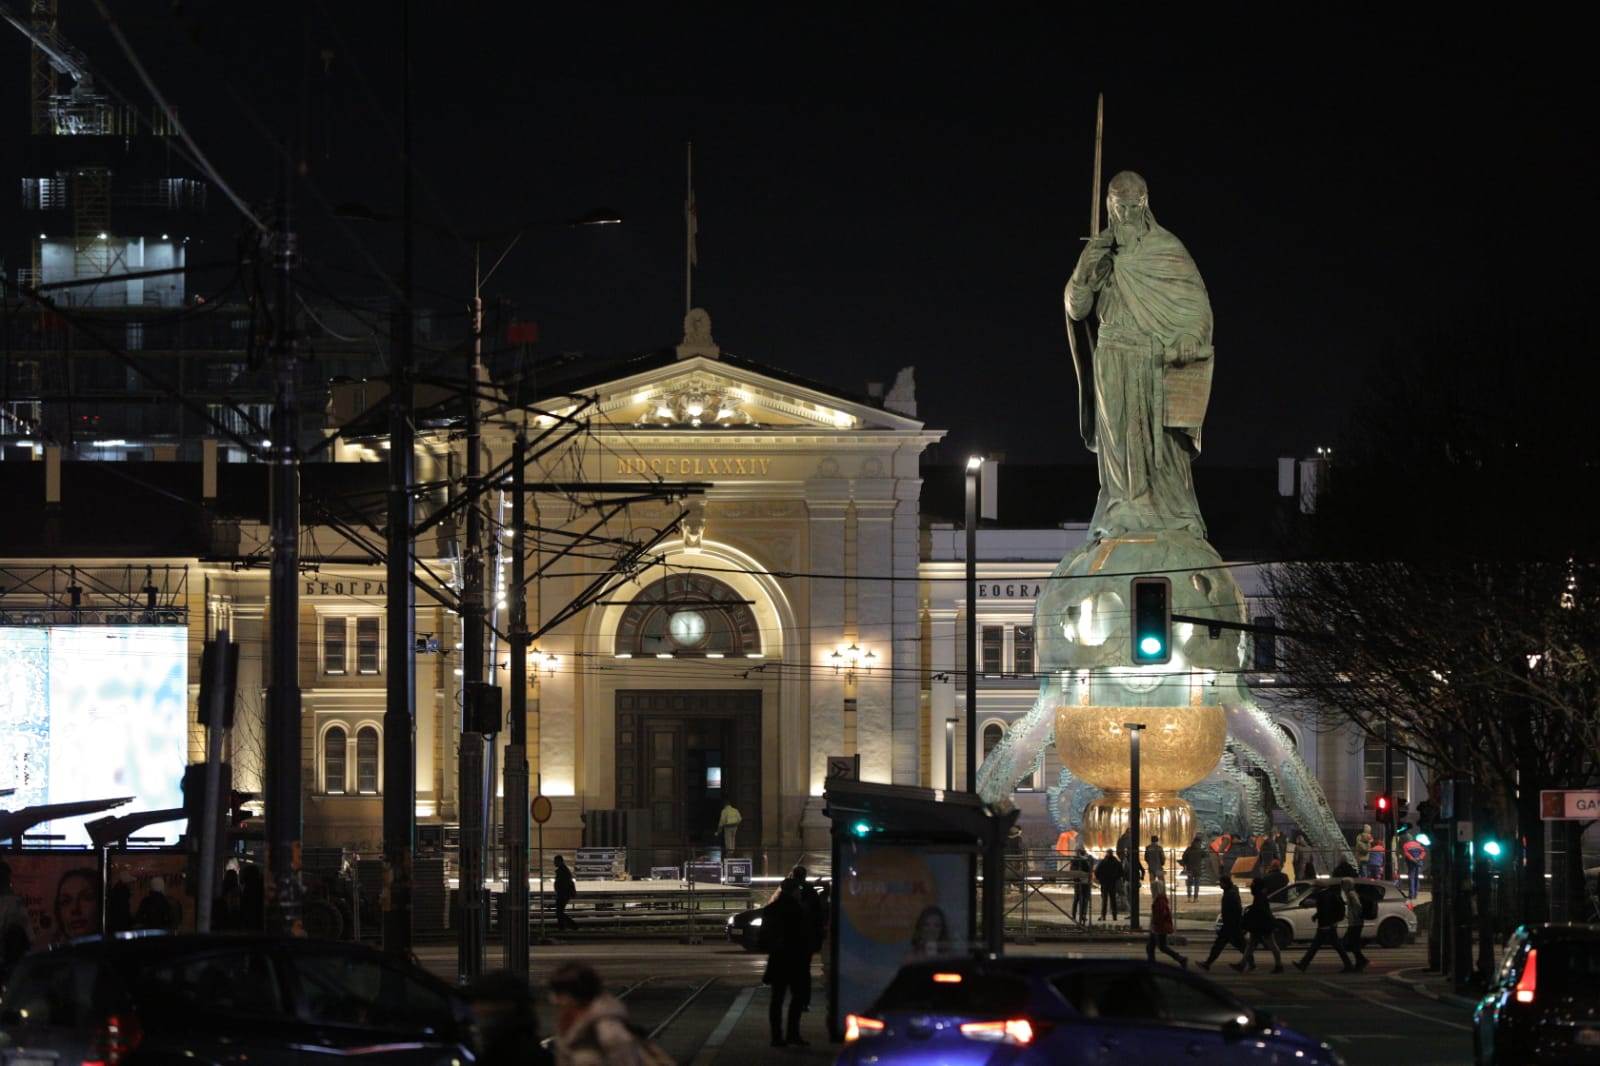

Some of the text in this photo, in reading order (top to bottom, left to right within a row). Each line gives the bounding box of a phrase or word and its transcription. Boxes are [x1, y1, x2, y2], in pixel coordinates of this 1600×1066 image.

[617, 458, 769, 474] MDCCCLXXXIV
[306, 582, 386, 595] БЕОГРА
[978, 584, 1041, 597] EOGRA
[1576, 799, 1600, 811] GA
